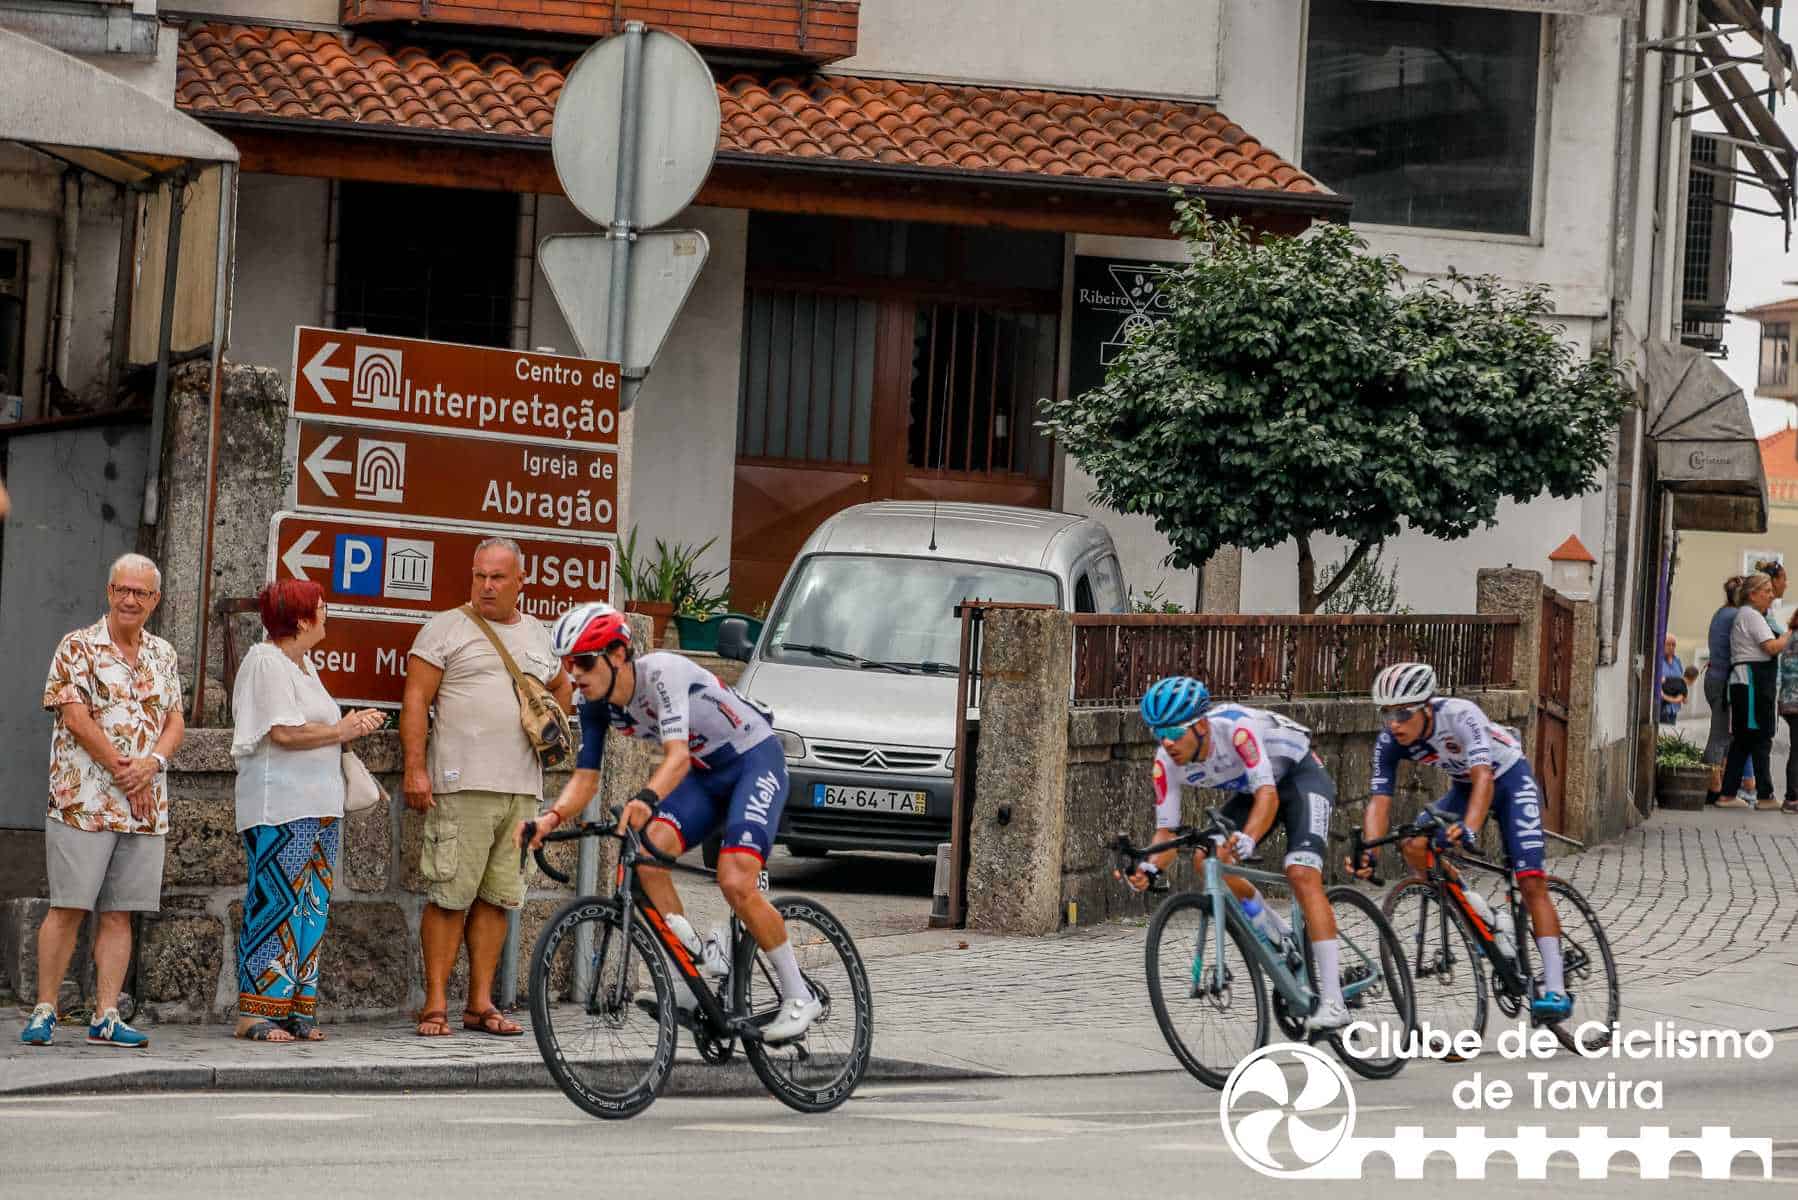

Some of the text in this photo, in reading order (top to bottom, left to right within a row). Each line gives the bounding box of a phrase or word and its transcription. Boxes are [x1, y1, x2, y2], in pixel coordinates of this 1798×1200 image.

[1079, 288, 1129, 306] Ribeiro
[514, 358, 616, 390] Centro de
[403, 378, 616, 441] Interpretação
[523, 450, 613, 480] Igreja de
[481, 479, 613, 527] Abragão
[343, 538, 373, 590] P
[520, 553, 607, 590] useu
[307, 649, 357, 673] seu
